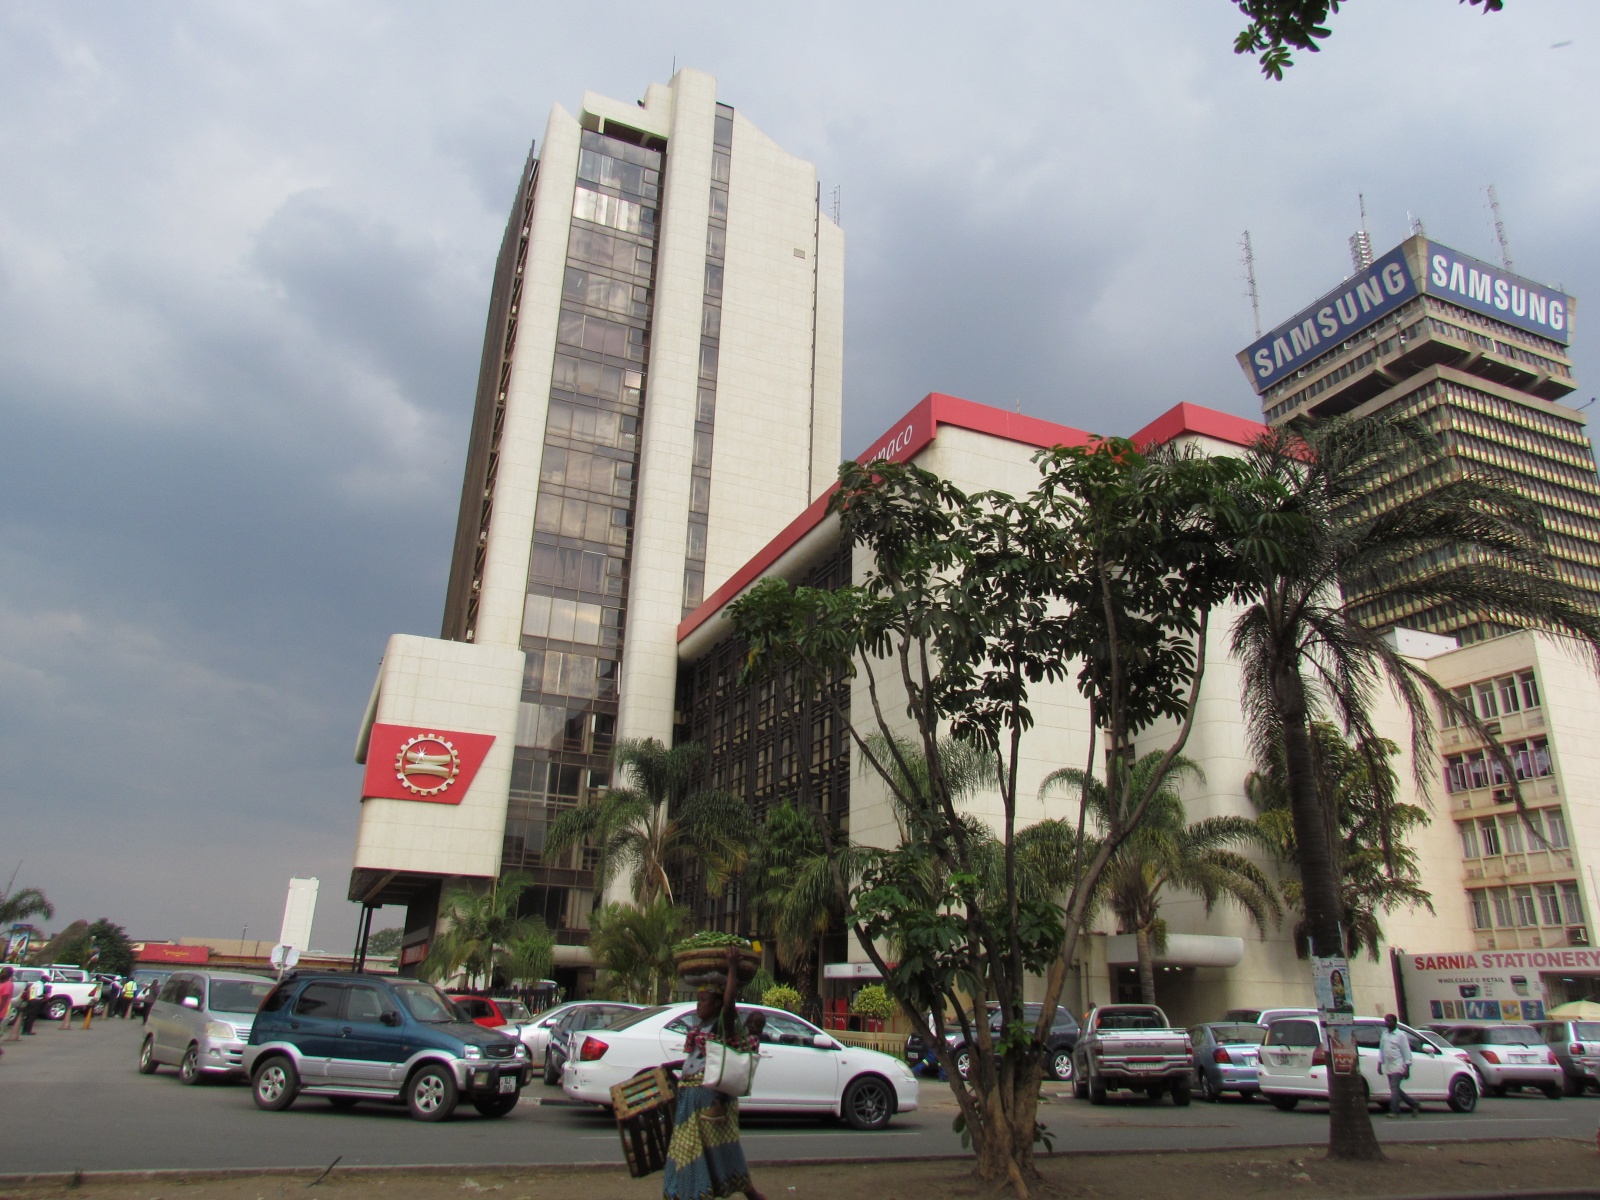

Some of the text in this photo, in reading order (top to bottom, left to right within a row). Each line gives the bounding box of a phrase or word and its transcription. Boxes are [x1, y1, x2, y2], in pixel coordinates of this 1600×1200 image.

[1254, 262, 1406, 378] SAMSUNG
[1431, 254, 1565, 331] SAMSUNG
[1414, 951, 1600, 970] SARNIA STATIONERY
